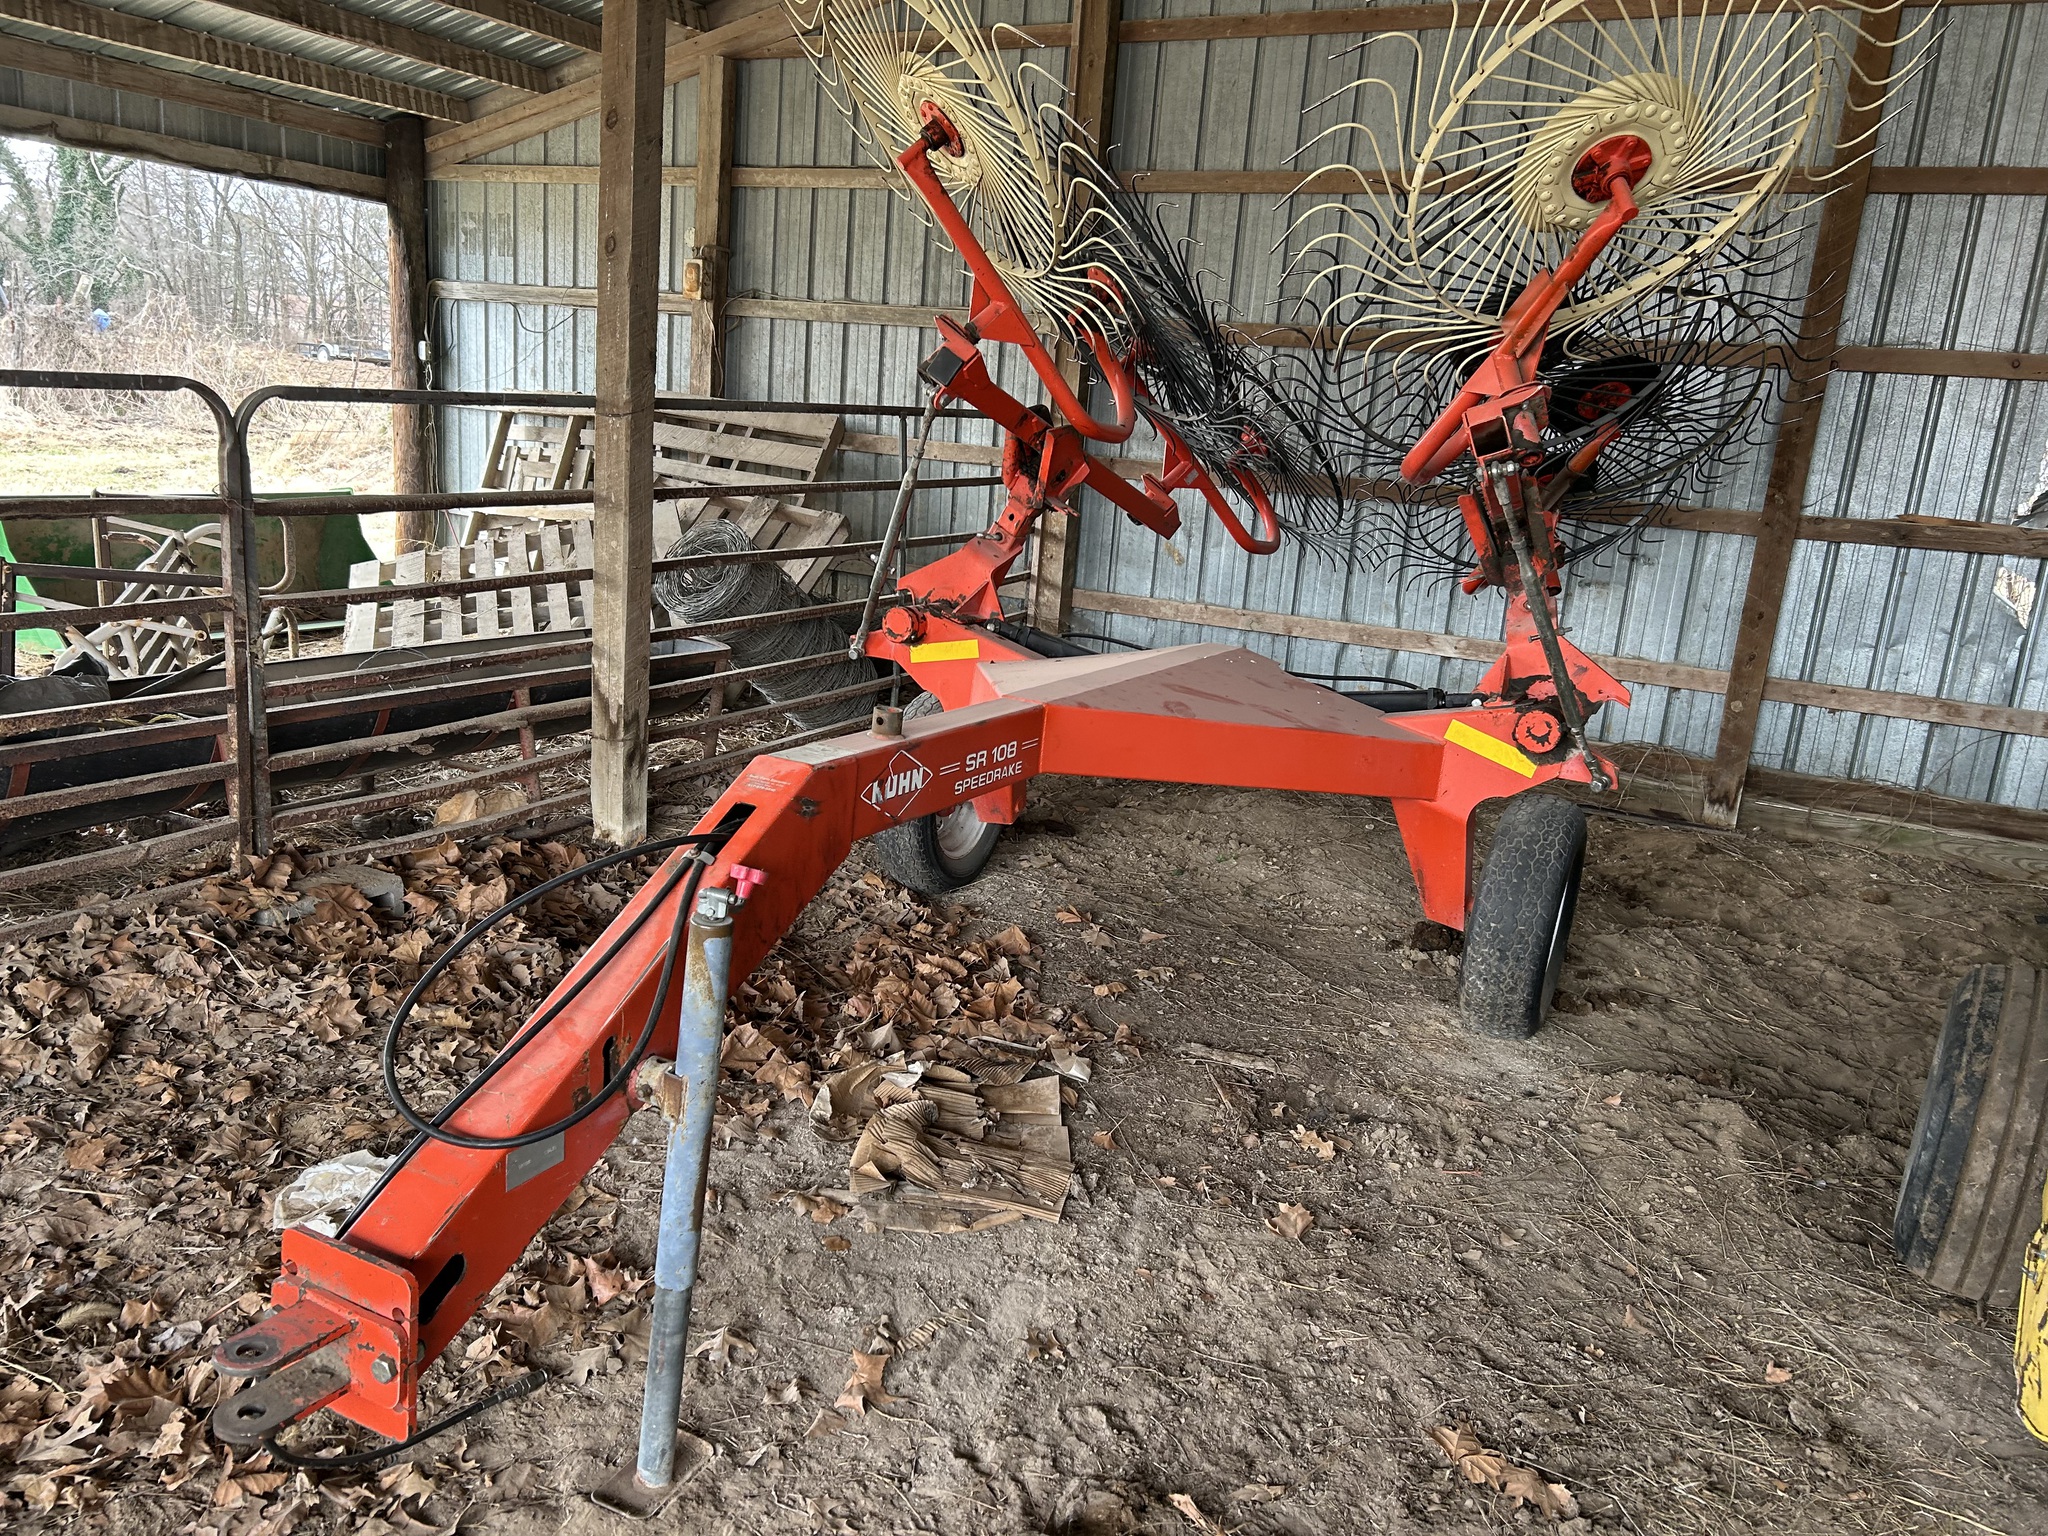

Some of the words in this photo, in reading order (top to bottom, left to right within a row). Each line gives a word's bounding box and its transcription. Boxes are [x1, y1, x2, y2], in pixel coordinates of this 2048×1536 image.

[965, 750, 987, 772] SR
[991, 741, 1017, 763] 108
[871, 767, 924, 804] KUHN
[954, 760, 1023, 795] SPEEDRAKE
